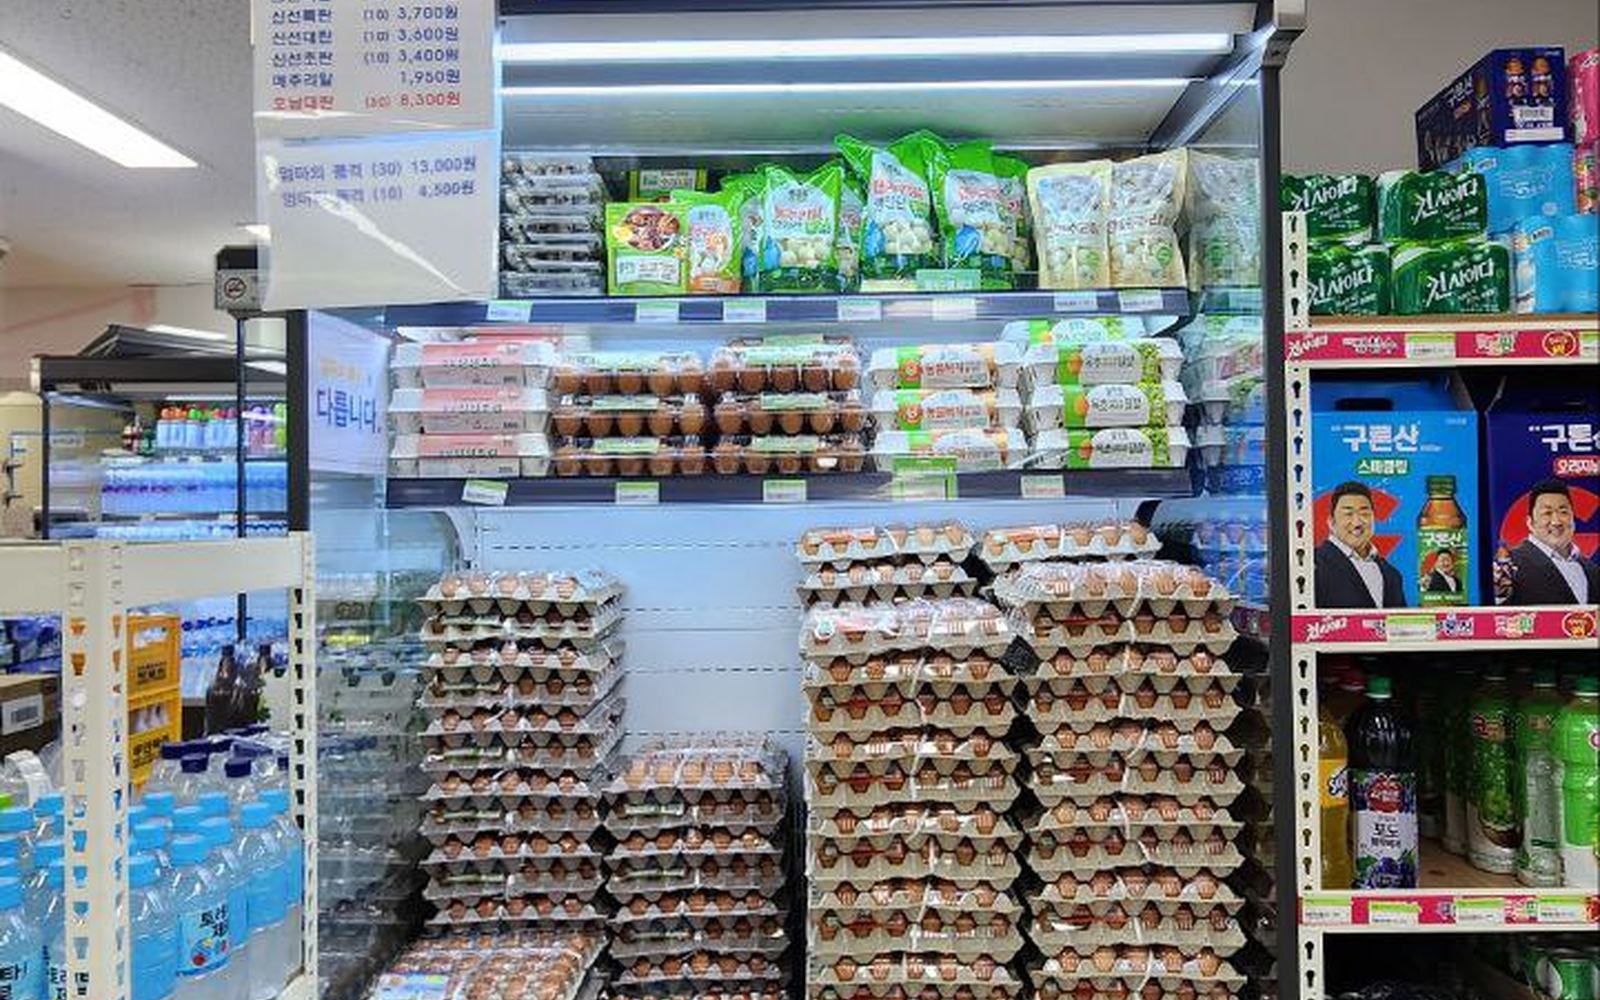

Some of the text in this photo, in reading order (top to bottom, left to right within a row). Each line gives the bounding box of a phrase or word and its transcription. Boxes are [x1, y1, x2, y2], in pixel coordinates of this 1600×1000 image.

[397, 6, 458, 21] 3,700원
[272, 30, 332, 46] 신선대란
[397, 27, 459, 43] 3,600원
[364, 52, 390, 64] (10)
[397, 48, 459, 64] 3,400원
[400, 69, 460, 85] 1,950원
[278, 165, 326, 184] 엄마의
[371, 161, 403, 177] (30)
[410, 155, 477, 175] 13,000원
[418, 180, 475, 198] 4,500원
